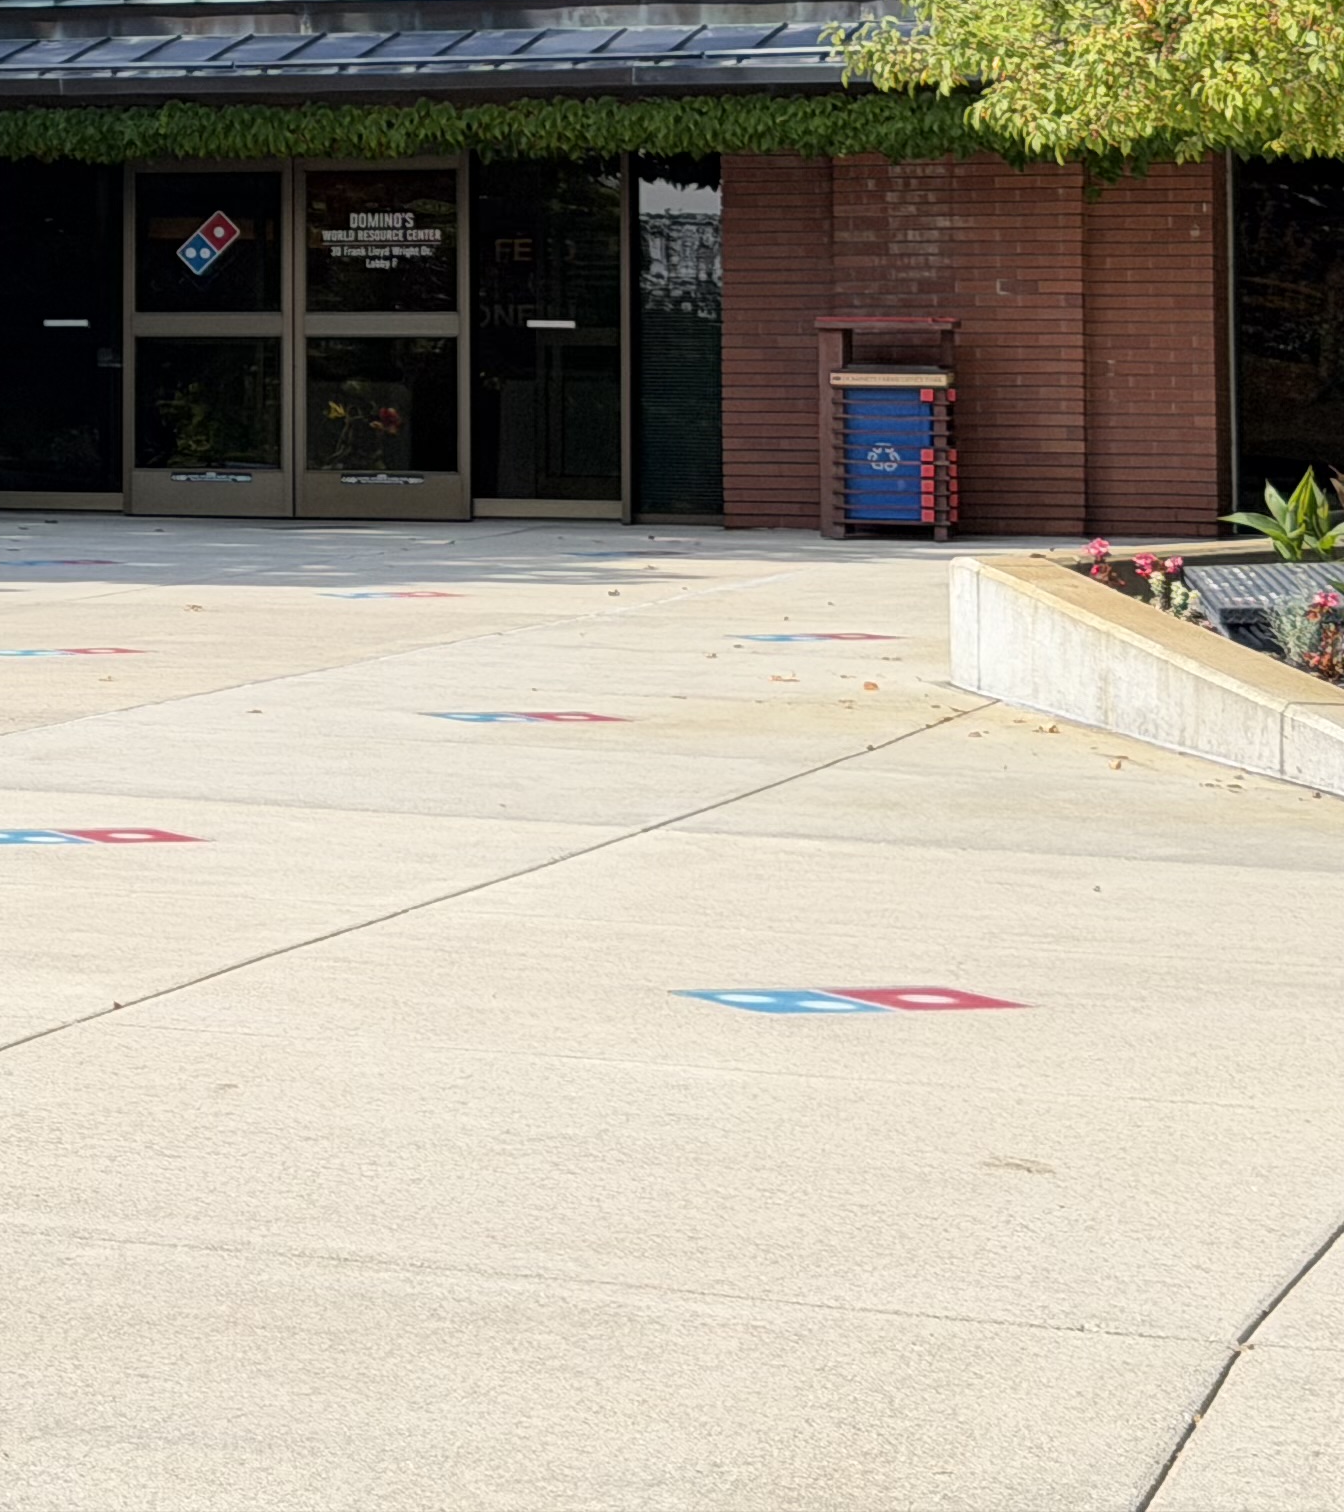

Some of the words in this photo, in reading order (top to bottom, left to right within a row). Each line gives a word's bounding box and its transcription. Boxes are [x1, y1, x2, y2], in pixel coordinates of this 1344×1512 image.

[349, 212, 415, 229] DOMINO'S
[321, 229, 356, 241] WORLD
[357, 229, 404, 241] RESOURCE
[407, 229, 442, 241] CENTER
[330, 246, 342, 257] 30
[344, 246, 366, 257] Frank
[368, 246, 390, 258] Lloyd
[391, 246, 419, 259] Wright
[365, 258, 390, 270] Lobby
